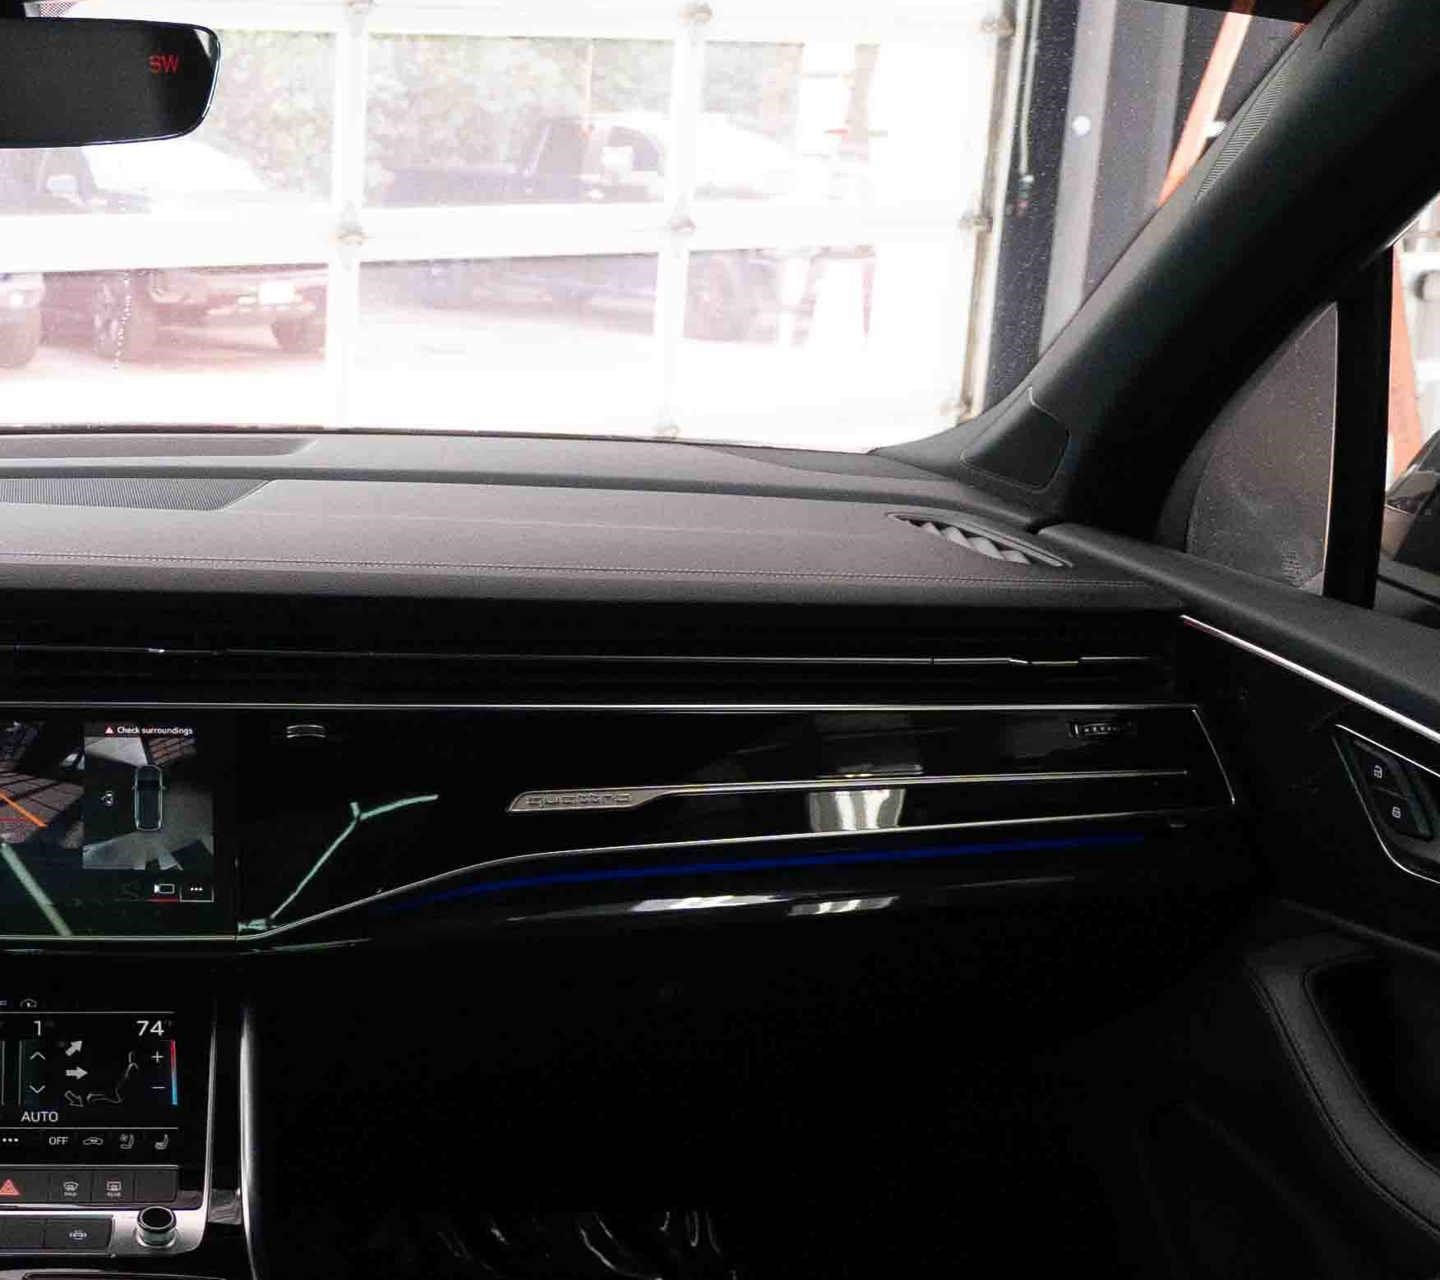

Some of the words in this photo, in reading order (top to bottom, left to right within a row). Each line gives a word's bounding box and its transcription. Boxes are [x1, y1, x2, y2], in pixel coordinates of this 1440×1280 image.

[149, 55, 178, 73] SW
[117, 726, 140, 734] Check
[142, 726, 193, 736] surroundings
[34, 1020, 42, 1036] 1
[137, 1020, 164, 1037] 74
[21, 1111, 59, 1123] AUTO
[49, 1136, 68, 1146] OFF
